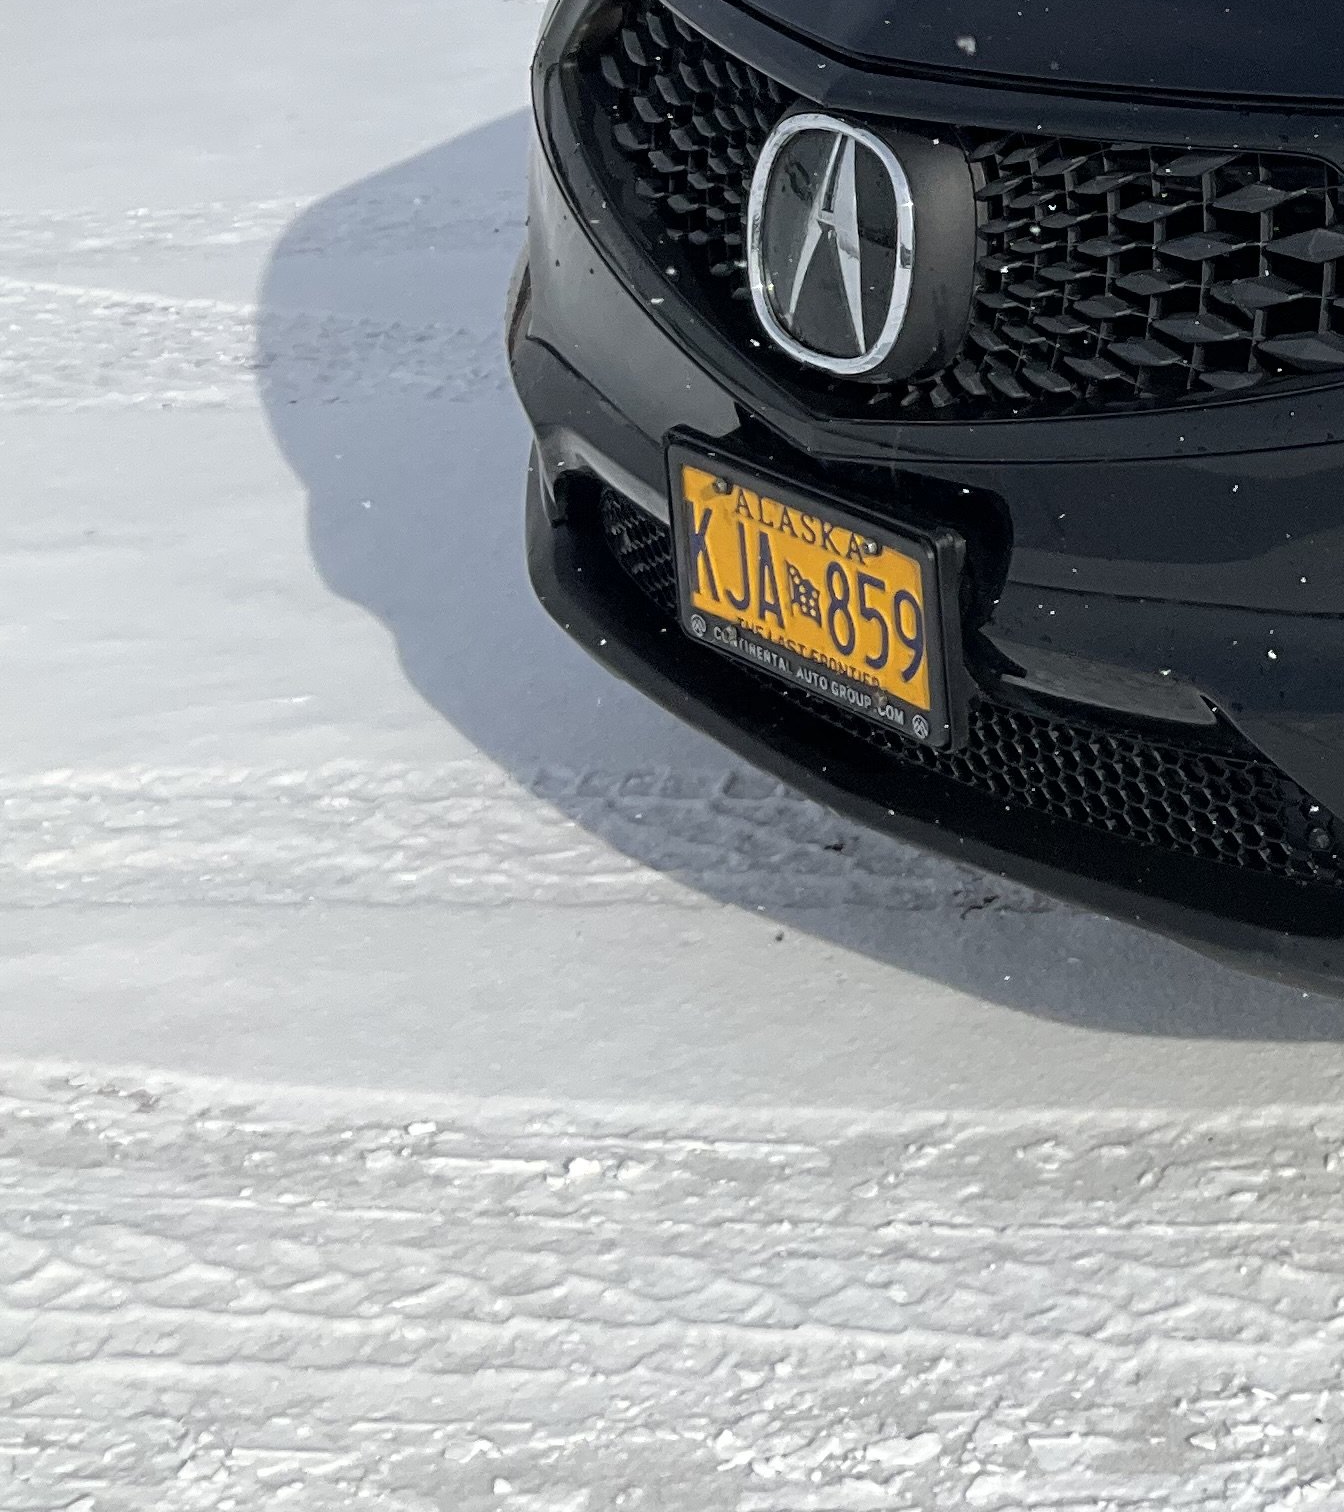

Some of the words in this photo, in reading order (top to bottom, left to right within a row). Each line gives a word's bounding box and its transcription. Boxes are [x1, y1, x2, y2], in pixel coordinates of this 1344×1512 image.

[735, 488, 867, 567] ALASKA
[687, 502, 786, 630] KJA
[827, 560, 926, 683] 859
[796, 667, 829, 690] AUTO
